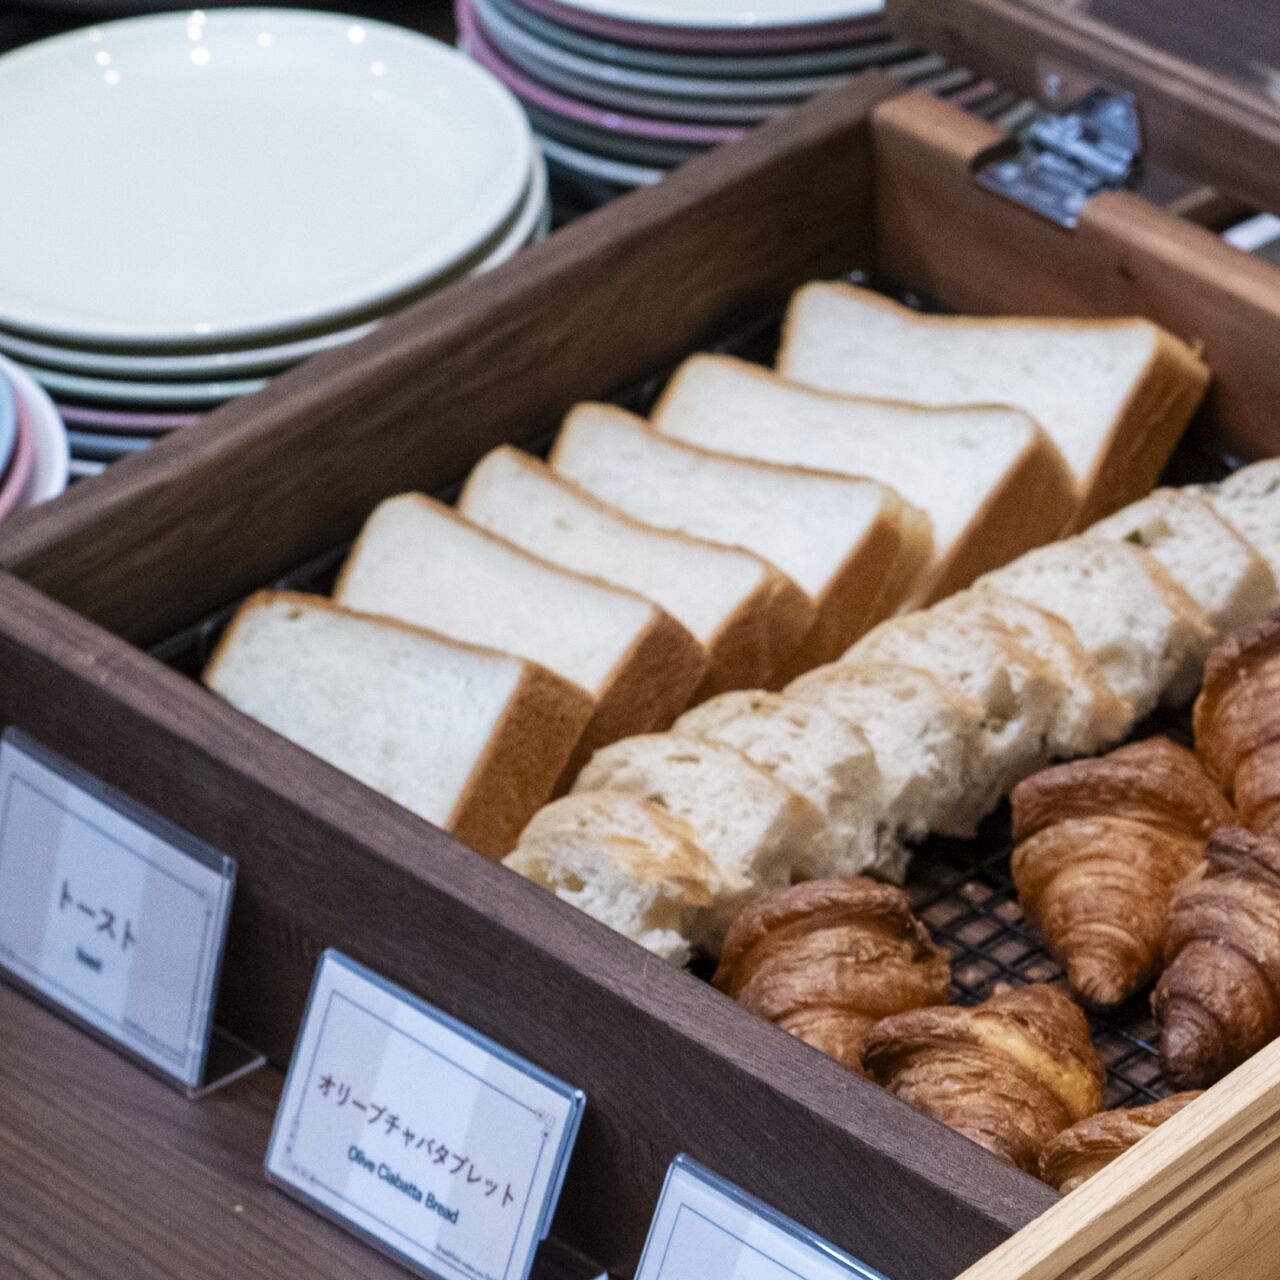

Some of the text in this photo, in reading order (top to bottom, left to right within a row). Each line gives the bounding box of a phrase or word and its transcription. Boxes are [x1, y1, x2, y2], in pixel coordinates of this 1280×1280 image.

[59, 879, 137, 950] トースト
[347, 1145, 460, 1225] Olive Ciabatta Bread
